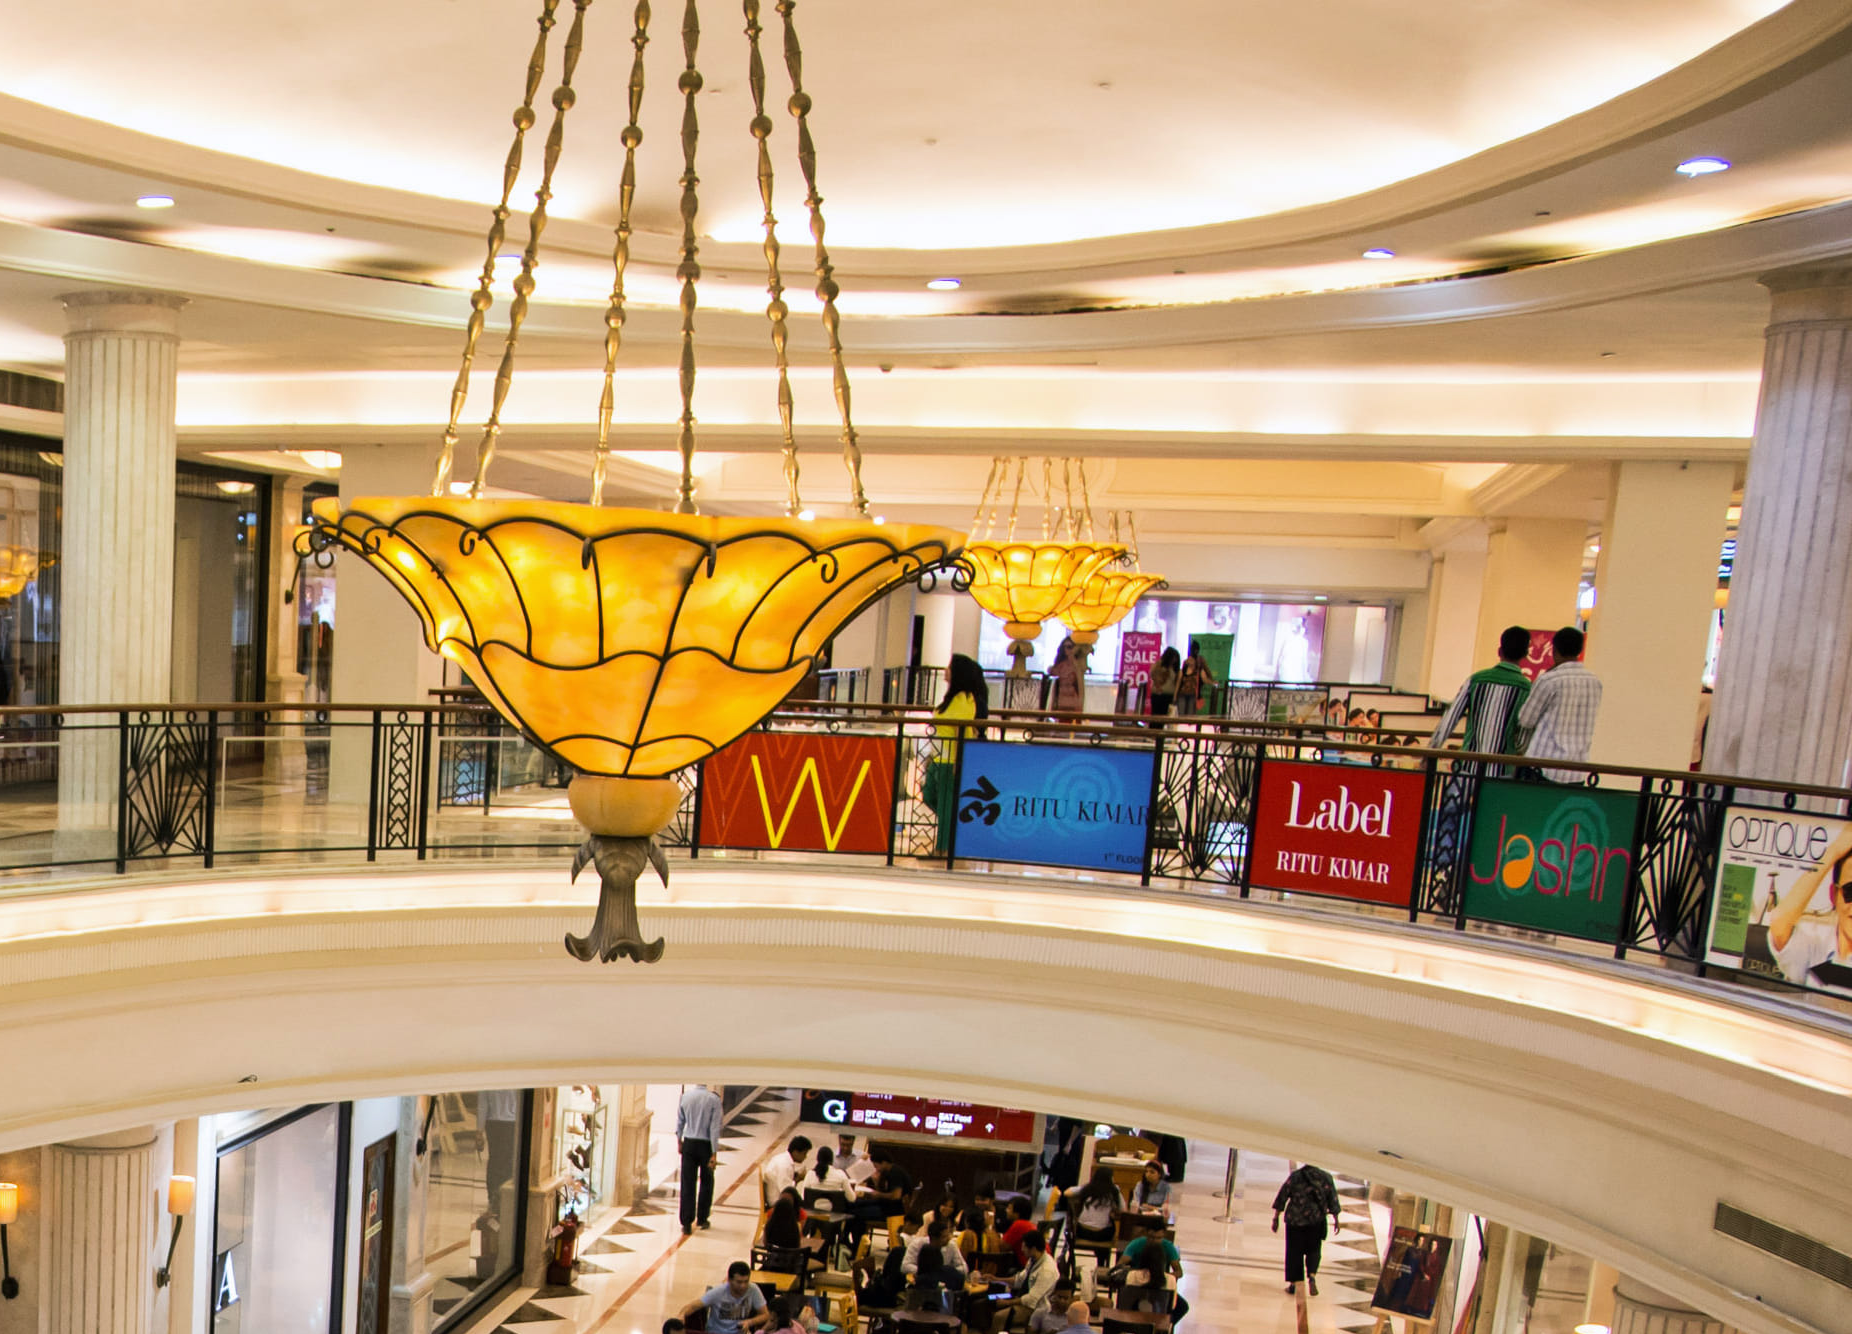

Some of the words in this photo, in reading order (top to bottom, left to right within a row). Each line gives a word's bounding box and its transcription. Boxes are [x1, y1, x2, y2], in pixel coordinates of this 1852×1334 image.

[1124, 650, 1158, 664] SALE
[750, 754, 872, 851] W
[1013, 795, 1069, 820] RITU
[1283, 780, 1391, 838] Label
[1275, 850, 1325, 876] RITU
[1327, 856, 1390, 885] KUMAR
[1470, 814, 1632, 907] Jashn
